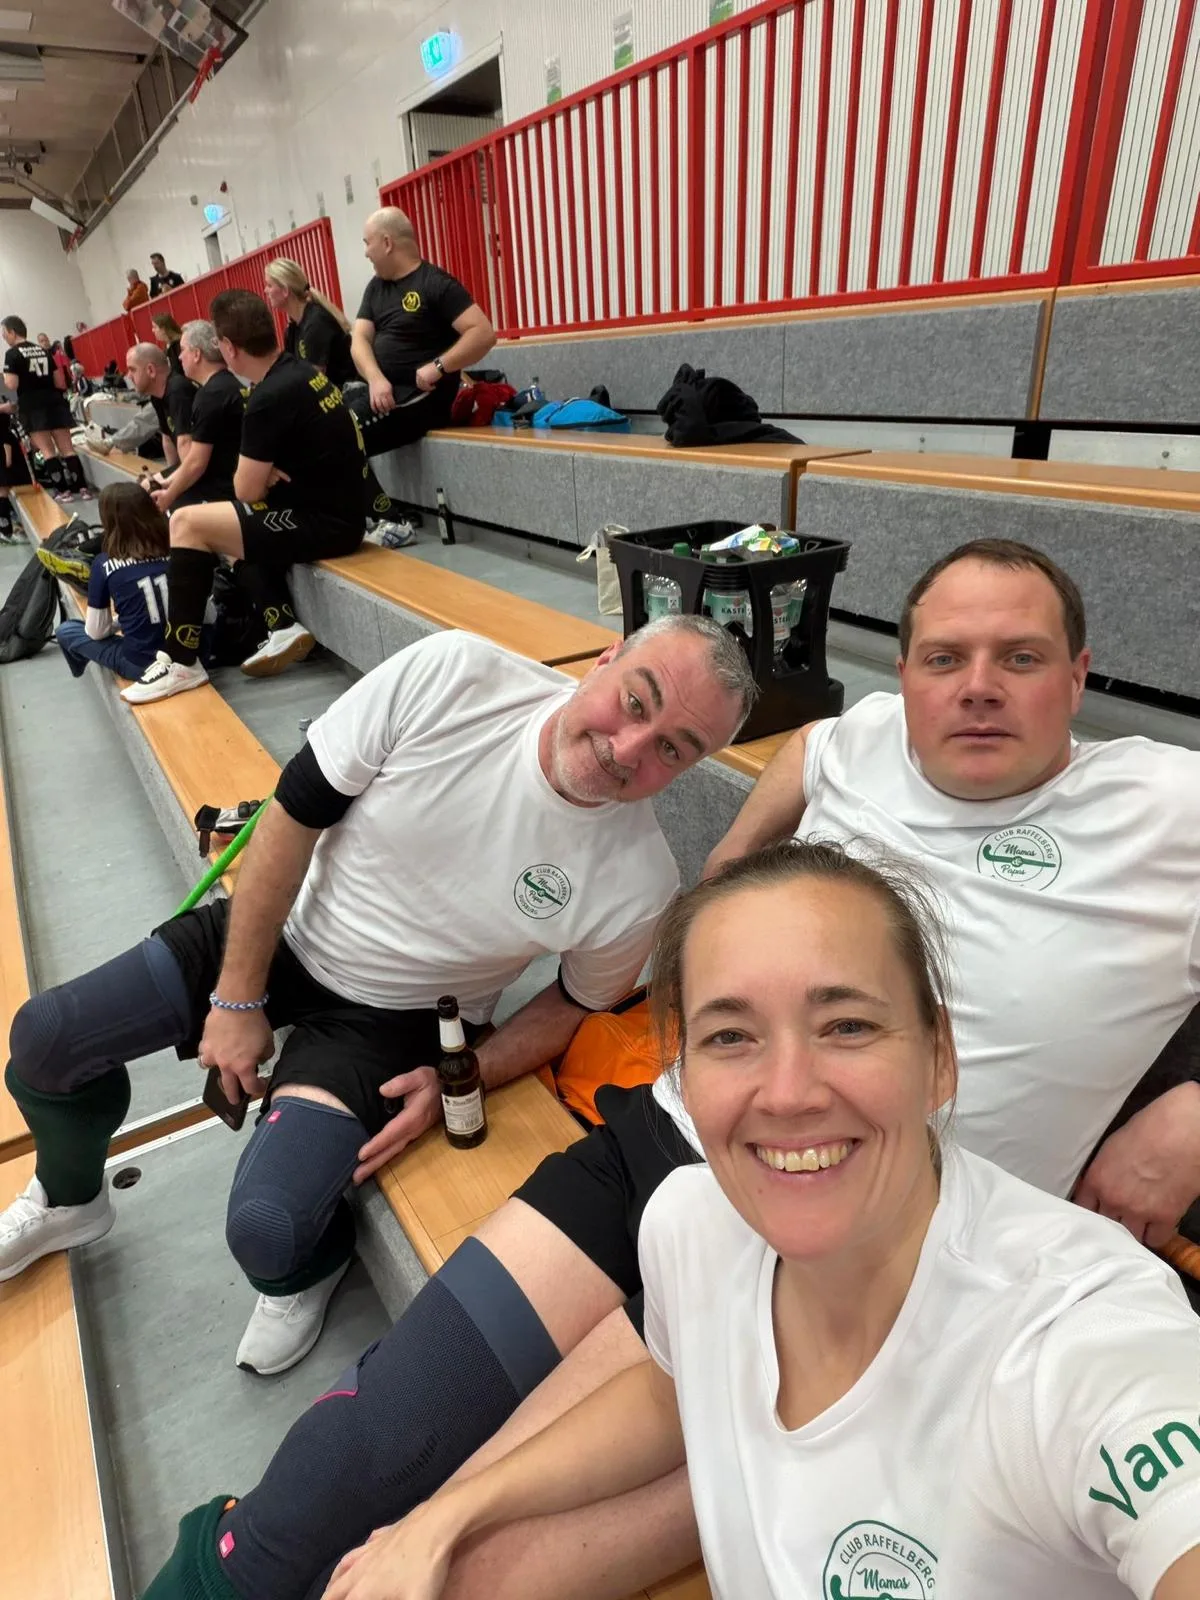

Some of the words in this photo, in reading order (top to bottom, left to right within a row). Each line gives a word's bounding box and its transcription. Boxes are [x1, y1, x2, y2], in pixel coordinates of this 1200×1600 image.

[29, 357, 49, 376] 47
[137, 574, 169, 625] 11
[994, 829, 1014, 842] CLUB
[1016, 828, 1055, 859] RAFFELBERG
[1002, 844, 1037, 857] Mamas
[1000, 864, 1026, 876] Papas
[1088, 1414, 1200, 1520] Van
[839, 1536, 863, 1565] CLUB
[863, 1533, 936, 1589] RAFFELBERG
[856, 1567, 911, 1592] Mamas
